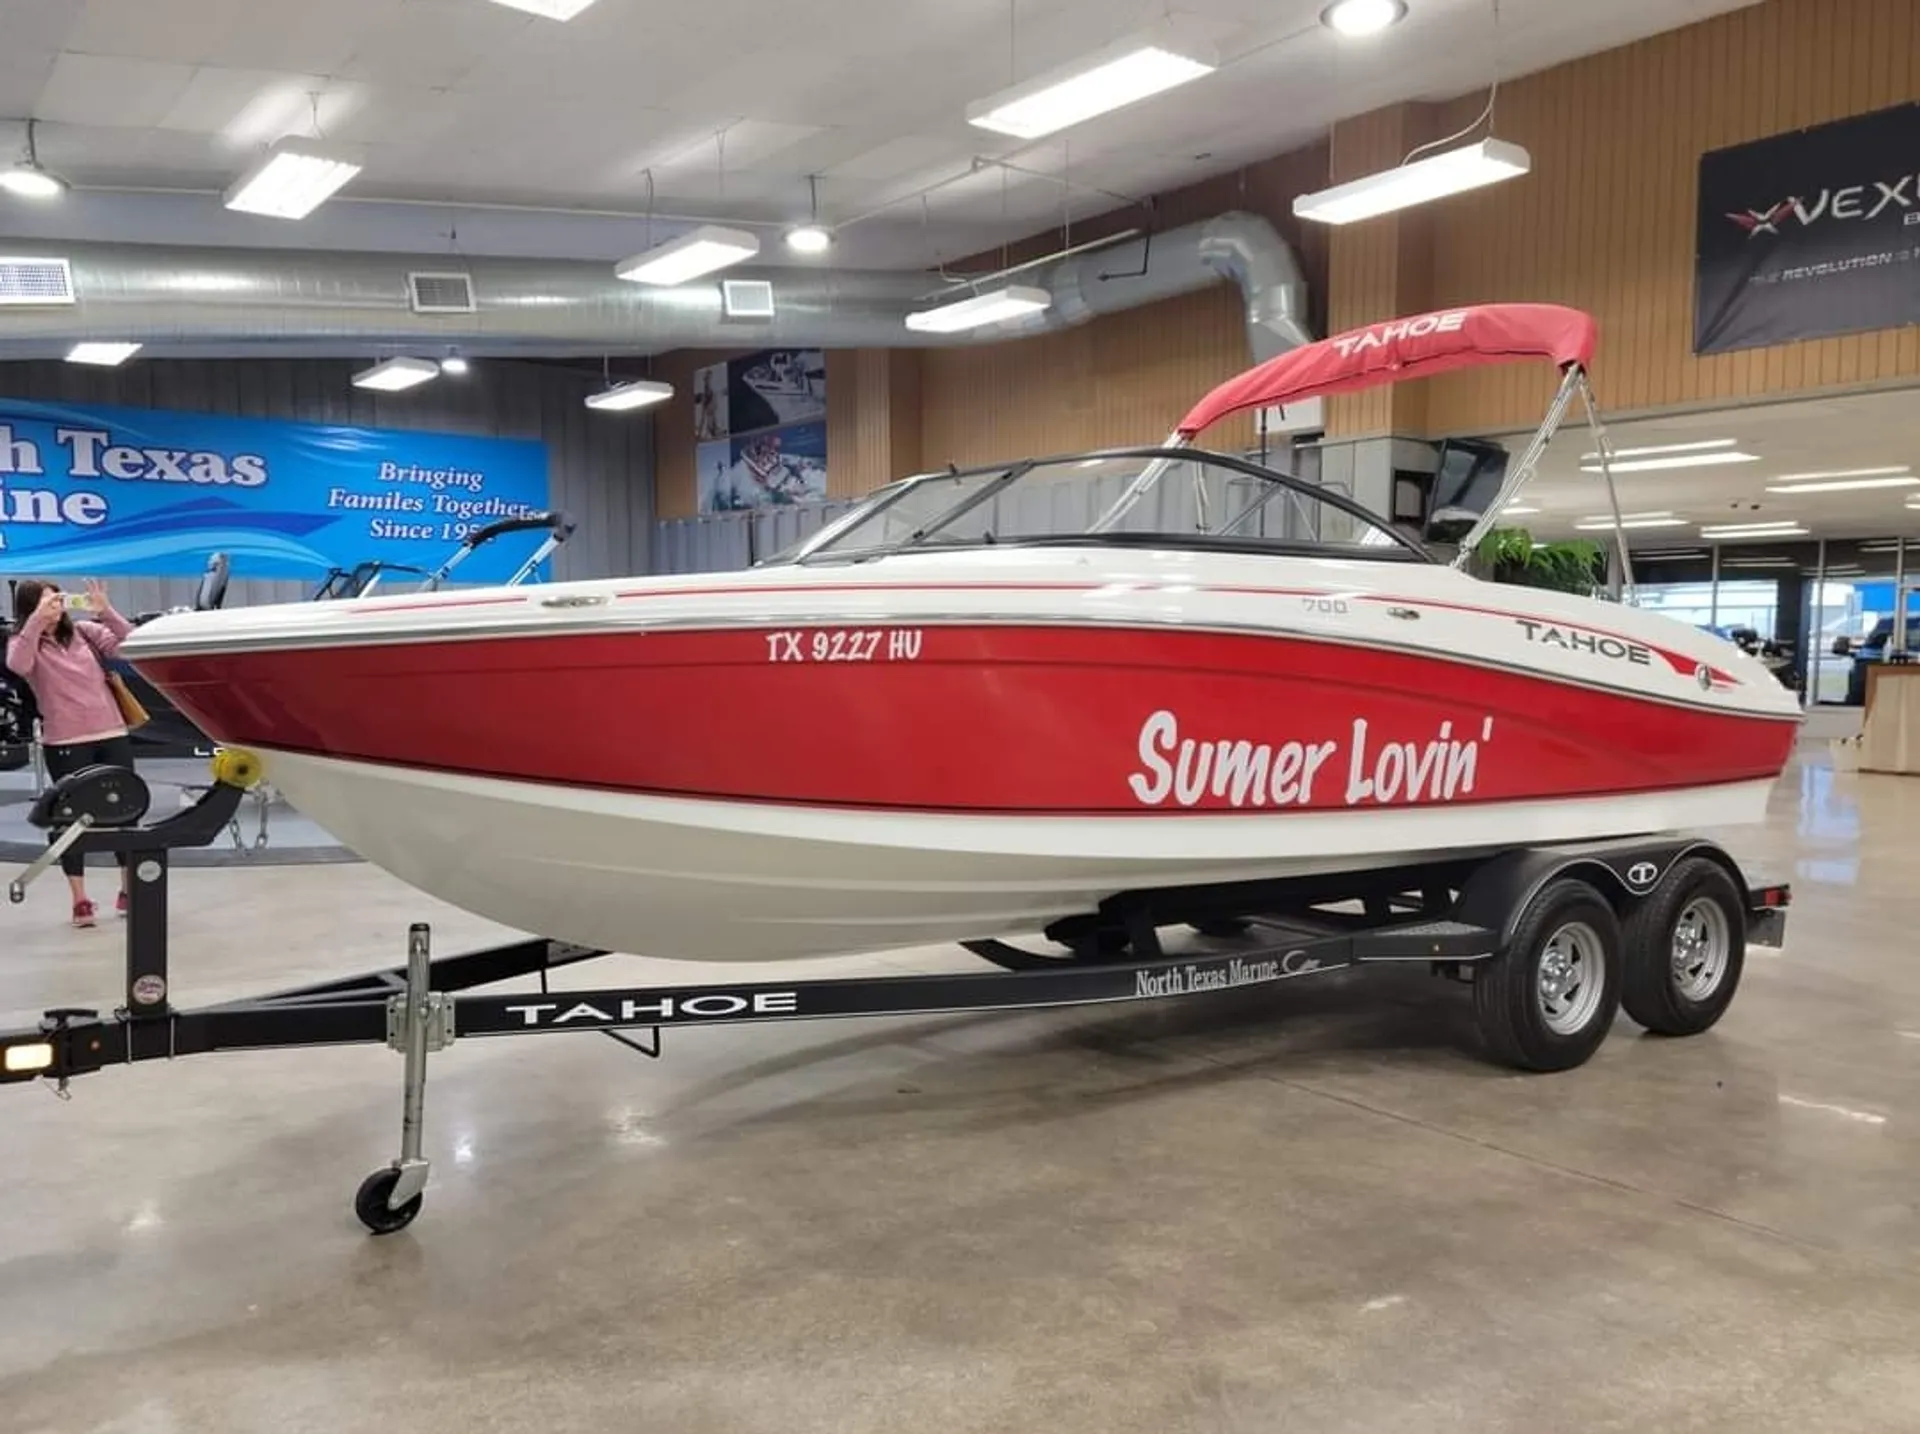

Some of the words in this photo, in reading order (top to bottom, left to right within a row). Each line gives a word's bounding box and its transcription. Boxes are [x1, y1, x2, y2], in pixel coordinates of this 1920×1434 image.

[1782, 252, 1893, 281] REVOLUTION
[1333, 311, 1468, 358] TAHOE
[57, 428, 267, 487] Texas
[379, 462, 484, 492] Bringing
[328, 488, 424, 512] Familes
[432, 494, 530, 519] Together
[370, 519, 433, 540] Since
[1302, 597, 1348, 614] 700
[765, 631, 804, 662] TX
[811, 631, 883, 662] 9227
[888, 630, 923, 661] HU
[1516, 619, 1652, 666] TAHOE
[1128, 710, 1337, 806] Sumer
[1345, 716, 1493, 805] Lovin'
[1135, 966, 1182, 998] North
[1185, 964, 1227, 991] Texas
[1229, 959, 1278, 985] Marine
[505, 992, 797, 1025] TAHOE
